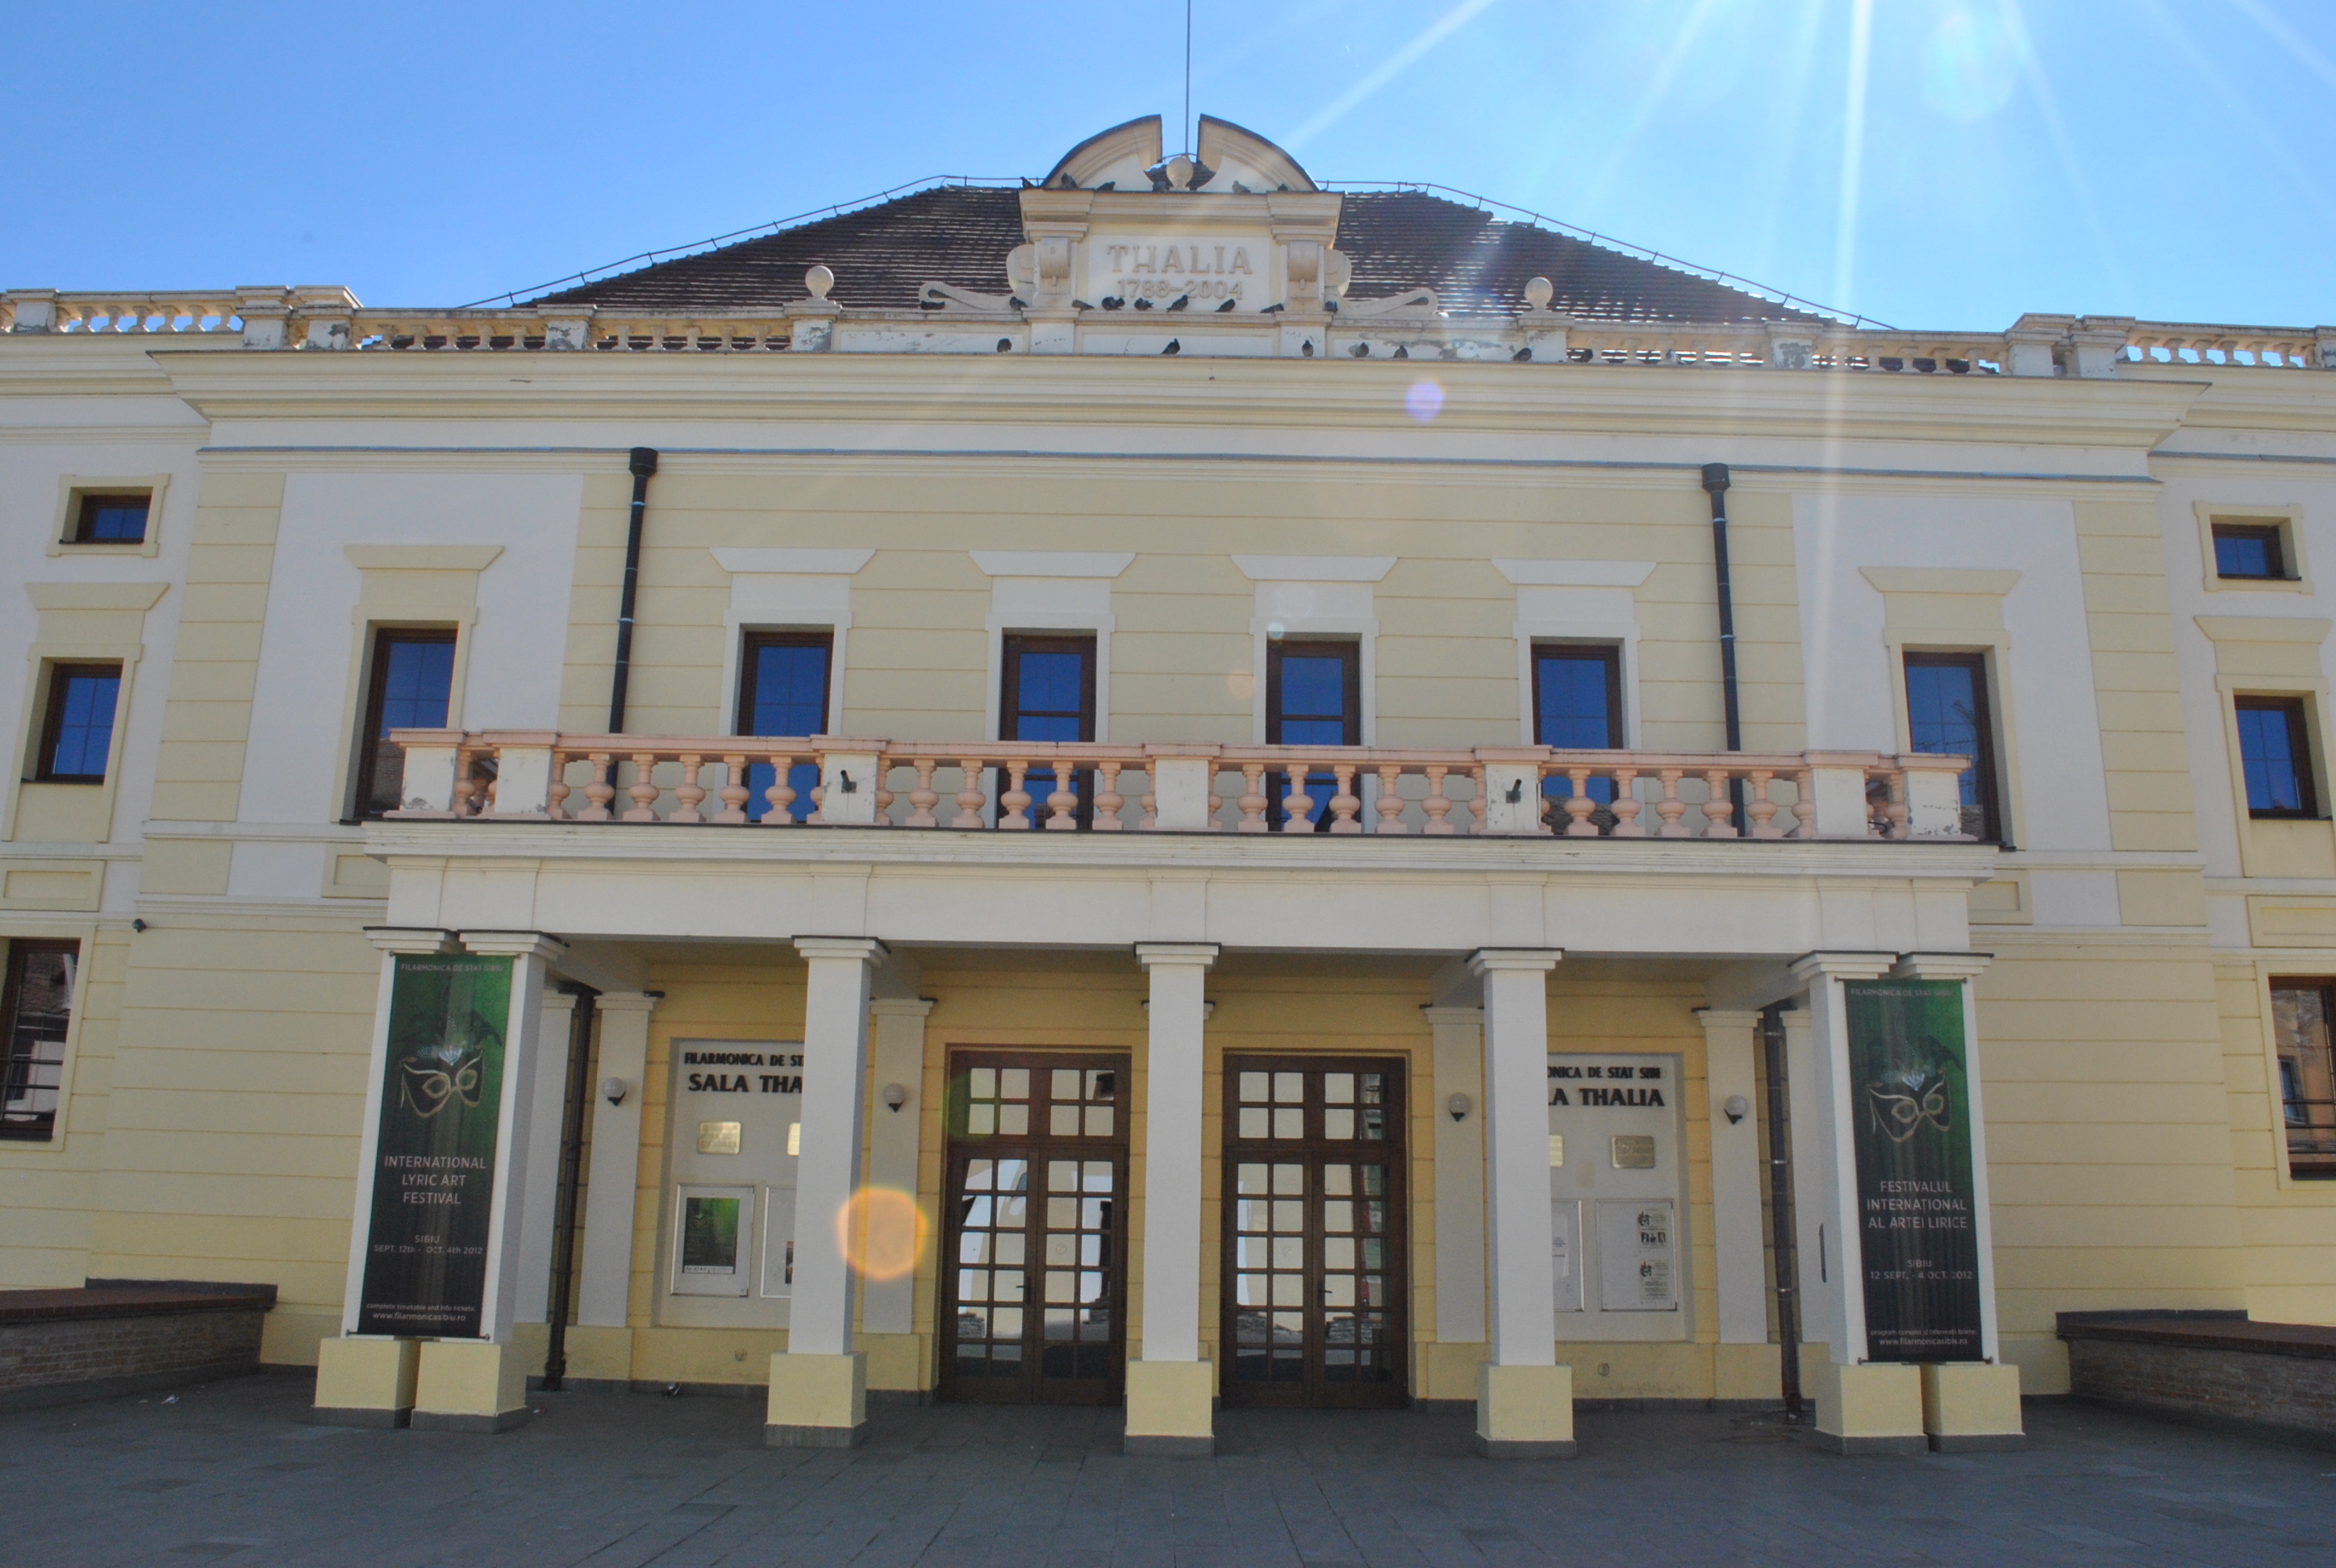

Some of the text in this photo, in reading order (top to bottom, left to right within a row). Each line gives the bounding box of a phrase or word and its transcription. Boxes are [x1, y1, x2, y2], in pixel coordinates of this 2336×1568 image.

[1107, 244, 1253, 275] THALIA
[1117, 278, 1244, 300] 1788-2004
[401, 963, 452, 972] FILARMONICA
[453, 964, 463, 972] DE
[465, 964, 482, 972] STAT
[684, 1052, 804, 1067] FILARMONICA DE ST
[1587, 1066, 1603, 1078] DE
[1607, 1066, 1635, 1079] STAT
[688, 1073, 803, 1094] SALA THA
[1579, 1087, 1666, 1107] THALIA
[384, 1155, 487, 1169] INTERNATIONAL
[402, 1174, 467, 1186] LYRIC ART
[1880, 1180, 1953, 1193] FESTIVALUL
[403, 1191, 462, 1204] FESTIVAL
[1868, 1216, 1968, 1228] AL ARTEI LIRICE
[415, 1235, 440, 1244] SIBIU
[398, 1245, 415, 1253] 12th
[446, 1246, 462, 1254] 4th
[463, 1246, 483, 1255] 2012
[1907, 1259, 1932, 1268] SIBIU
[1871, 1271, 1880, 1280] 12
[1918, 1271, 1925, 1279] 4
[1951, 1271, 1973, 1280] 2012
